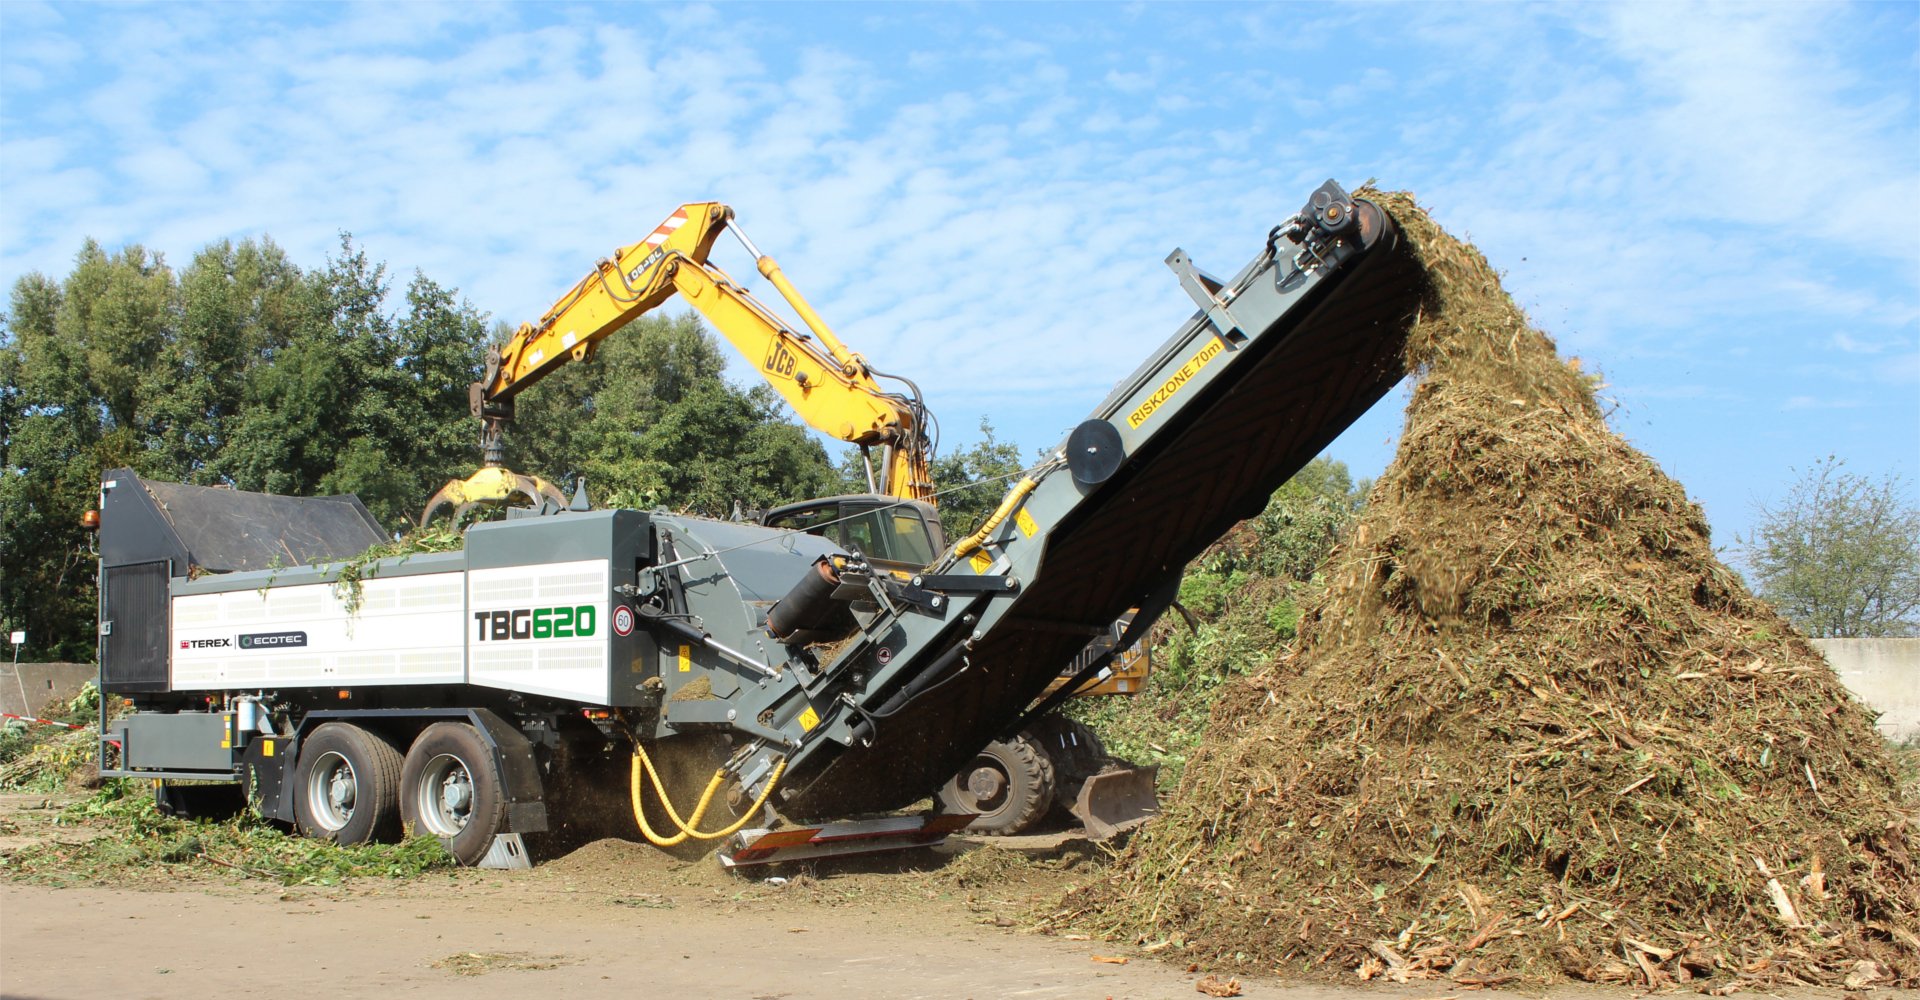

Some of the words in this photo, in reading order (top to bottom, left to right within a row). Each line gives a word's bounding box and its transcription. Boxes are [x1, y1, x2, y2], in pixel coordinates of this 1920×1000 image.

[766, 341, 795, 375] JCB
[1130, 365, 1194, 426] RISKZONE
[1193, 343, 1221, 368] 70m
[474, 605, 597, 641] TBG620
[617, 614, 629, 628] 60
[191, 638, 231, 649] TEREX
[254, 635, 302, 645] ECOTEC
